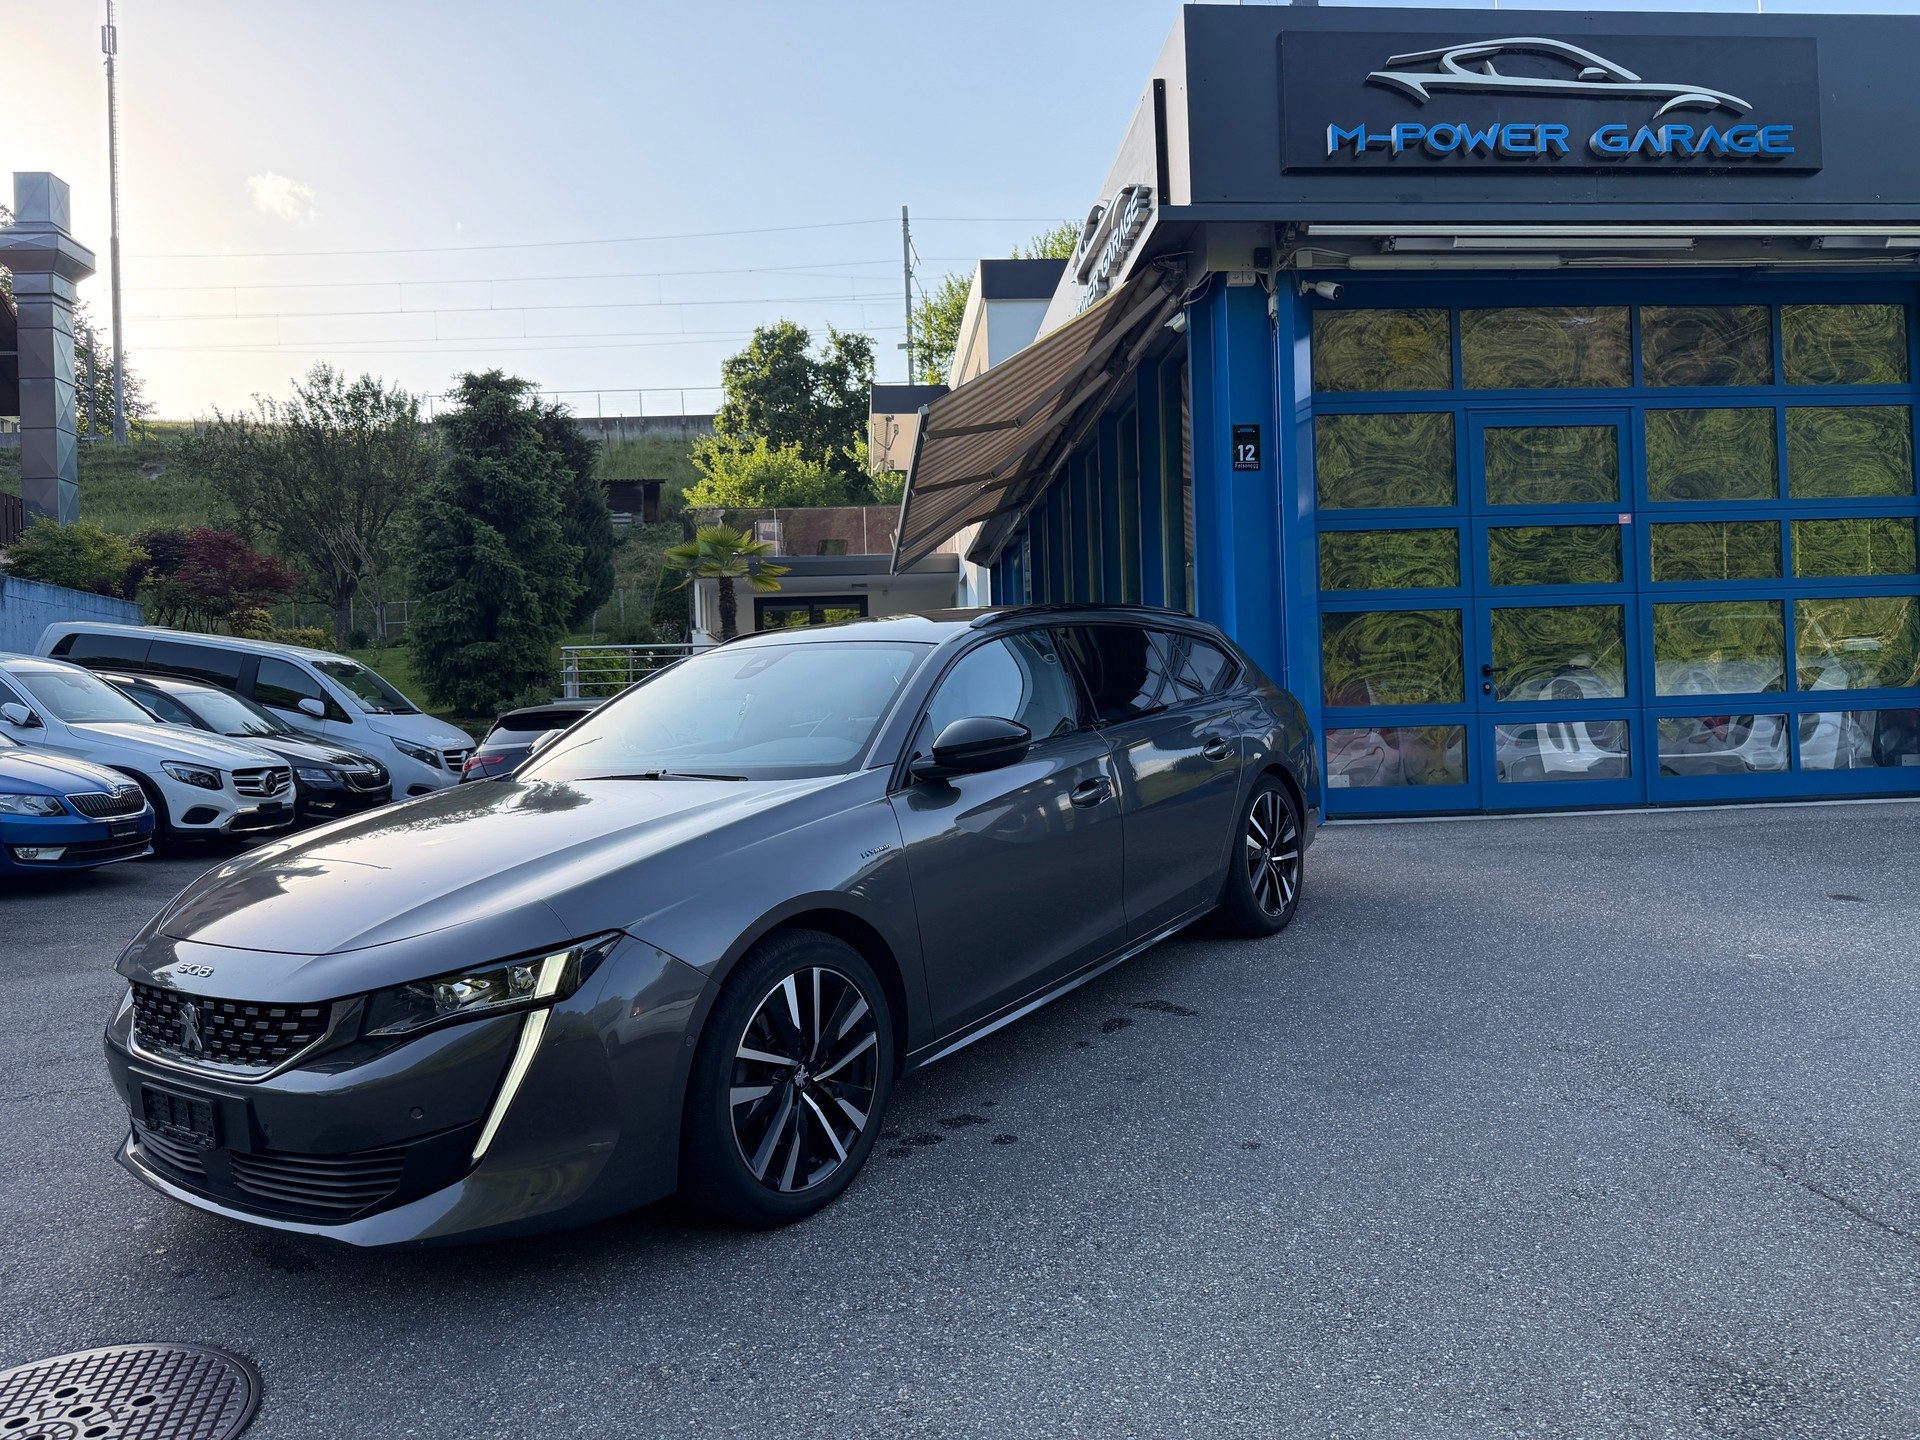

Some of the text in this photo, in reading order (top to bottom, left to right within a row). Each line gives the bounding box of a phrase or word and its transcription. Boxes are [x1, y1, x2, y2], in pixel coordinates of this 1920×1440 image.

[1328, 122, 1796, 157] M-POWER GARAGE
[1237, 444, 1256, 462] 12
[177, 962, 214, 978] 508
